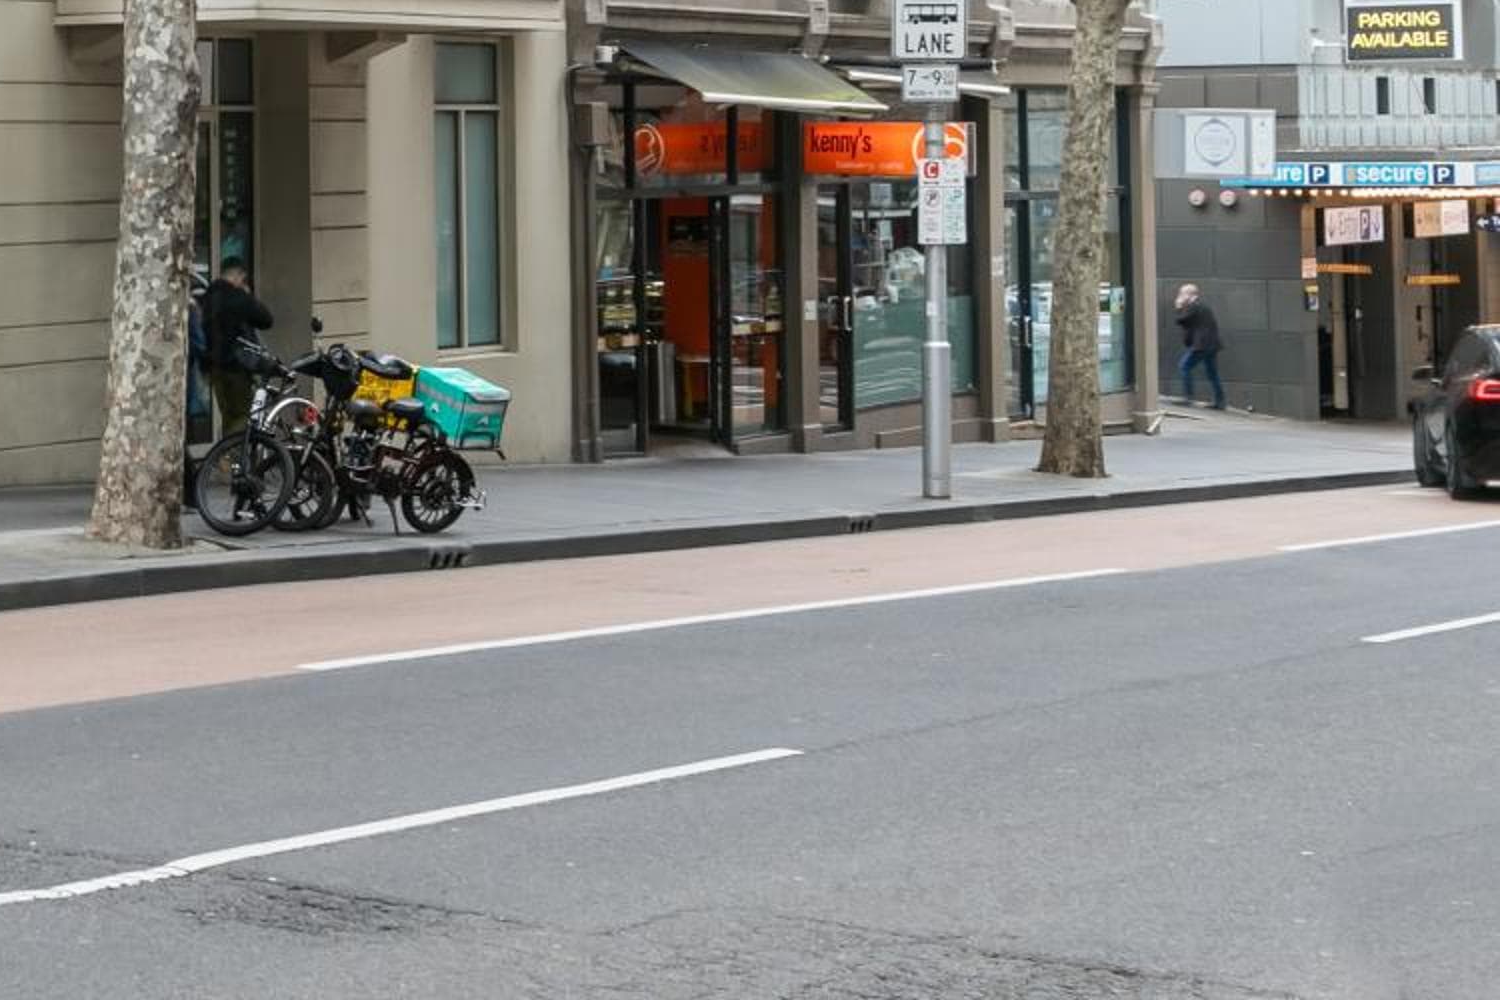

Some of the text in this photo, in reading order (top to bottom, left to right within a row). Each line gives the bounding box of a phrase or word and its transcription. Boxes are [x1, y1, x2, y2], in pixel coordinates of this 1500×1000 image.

[1358, 11, 1441, 29] PARKING
[904, 32, 954, 53] LANE
[1350, 31, 1449, 48] AVAILABLE
[810, 129, 872, 159] kenny's
[1357, 166, 1426, 183] secure
